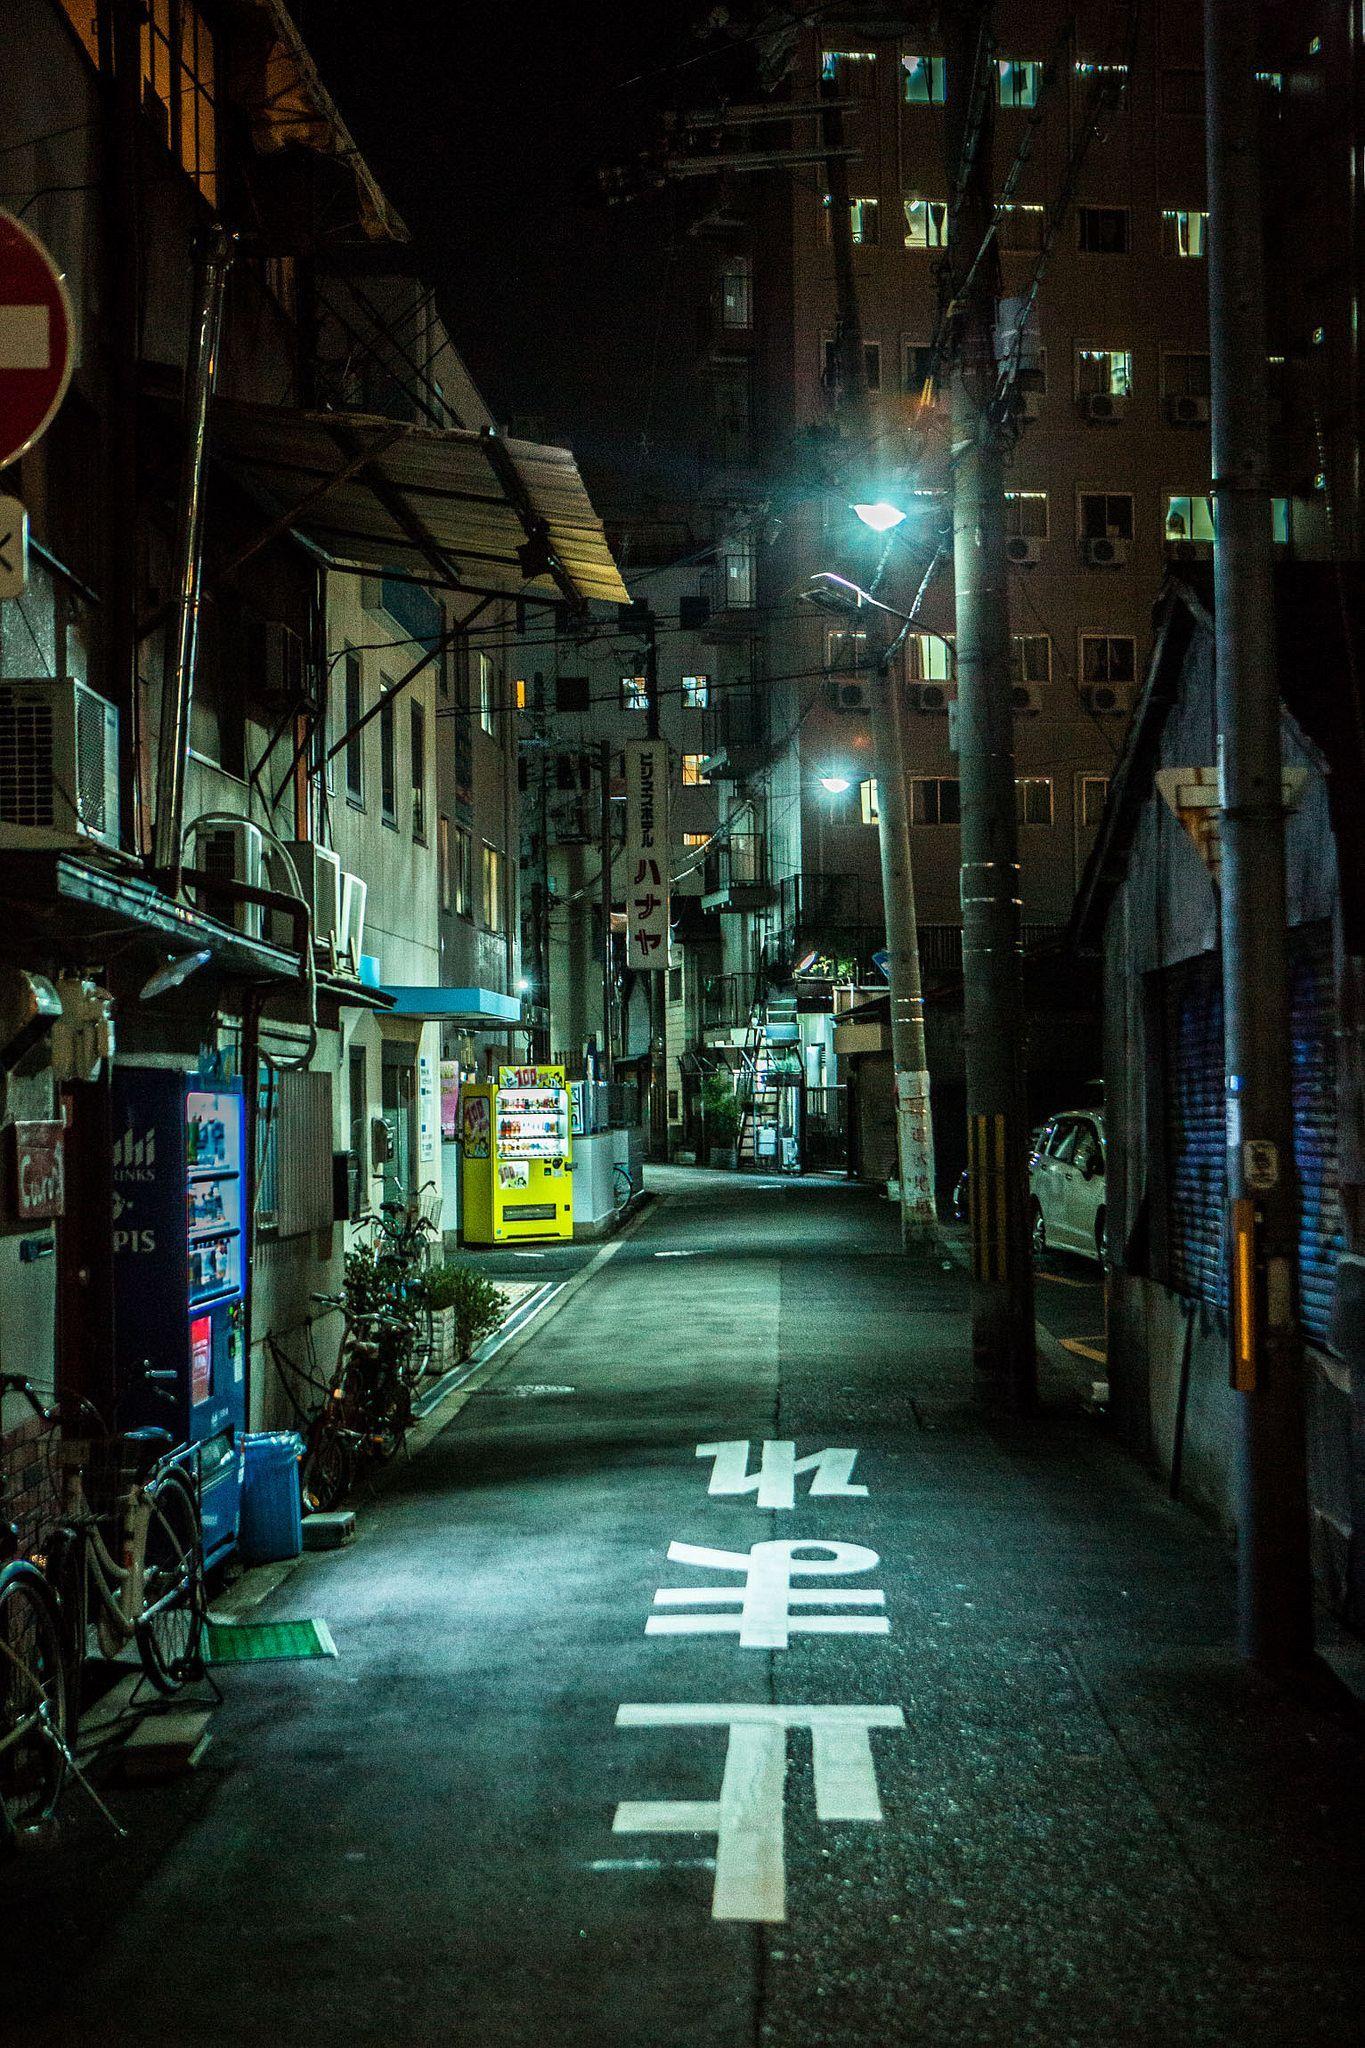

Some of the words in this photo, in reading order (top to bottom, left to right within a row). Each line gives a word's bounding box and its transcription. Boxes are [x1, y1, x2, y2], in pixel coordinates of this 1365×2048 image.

[640, 752, 654, 848] ビジネスホテル
[634, 859, 662, 955] ハナヤ
